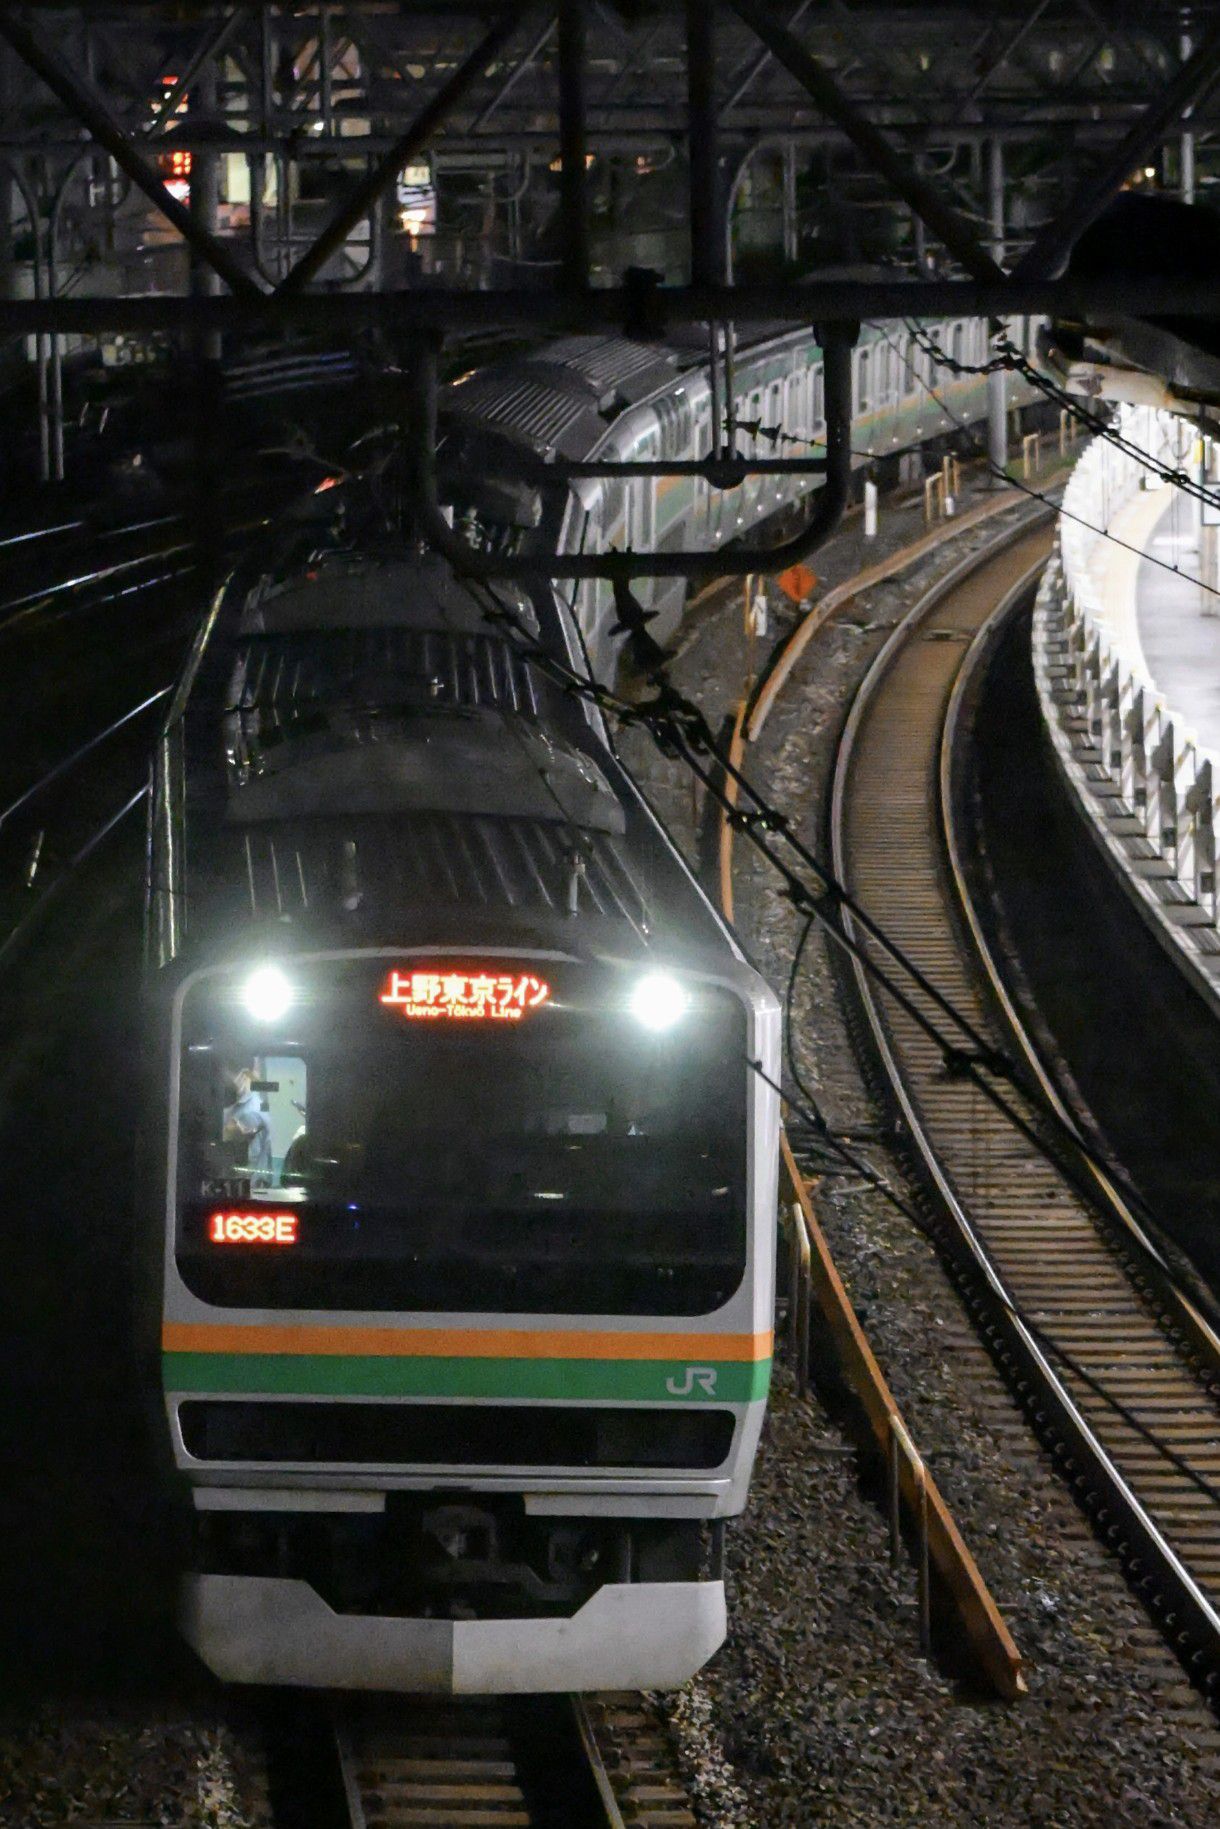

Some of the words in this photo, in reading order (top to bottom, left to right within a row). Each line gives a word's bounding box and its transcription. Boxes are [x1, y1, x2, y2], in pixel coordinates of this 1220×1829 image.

[379, 971, 549, 1006] 上野東京ライン
[490, 1005, 522, 1019] Line
[212, 1215, 296, 1241] 1633E
[666, 1366, 718, 1396] JR
